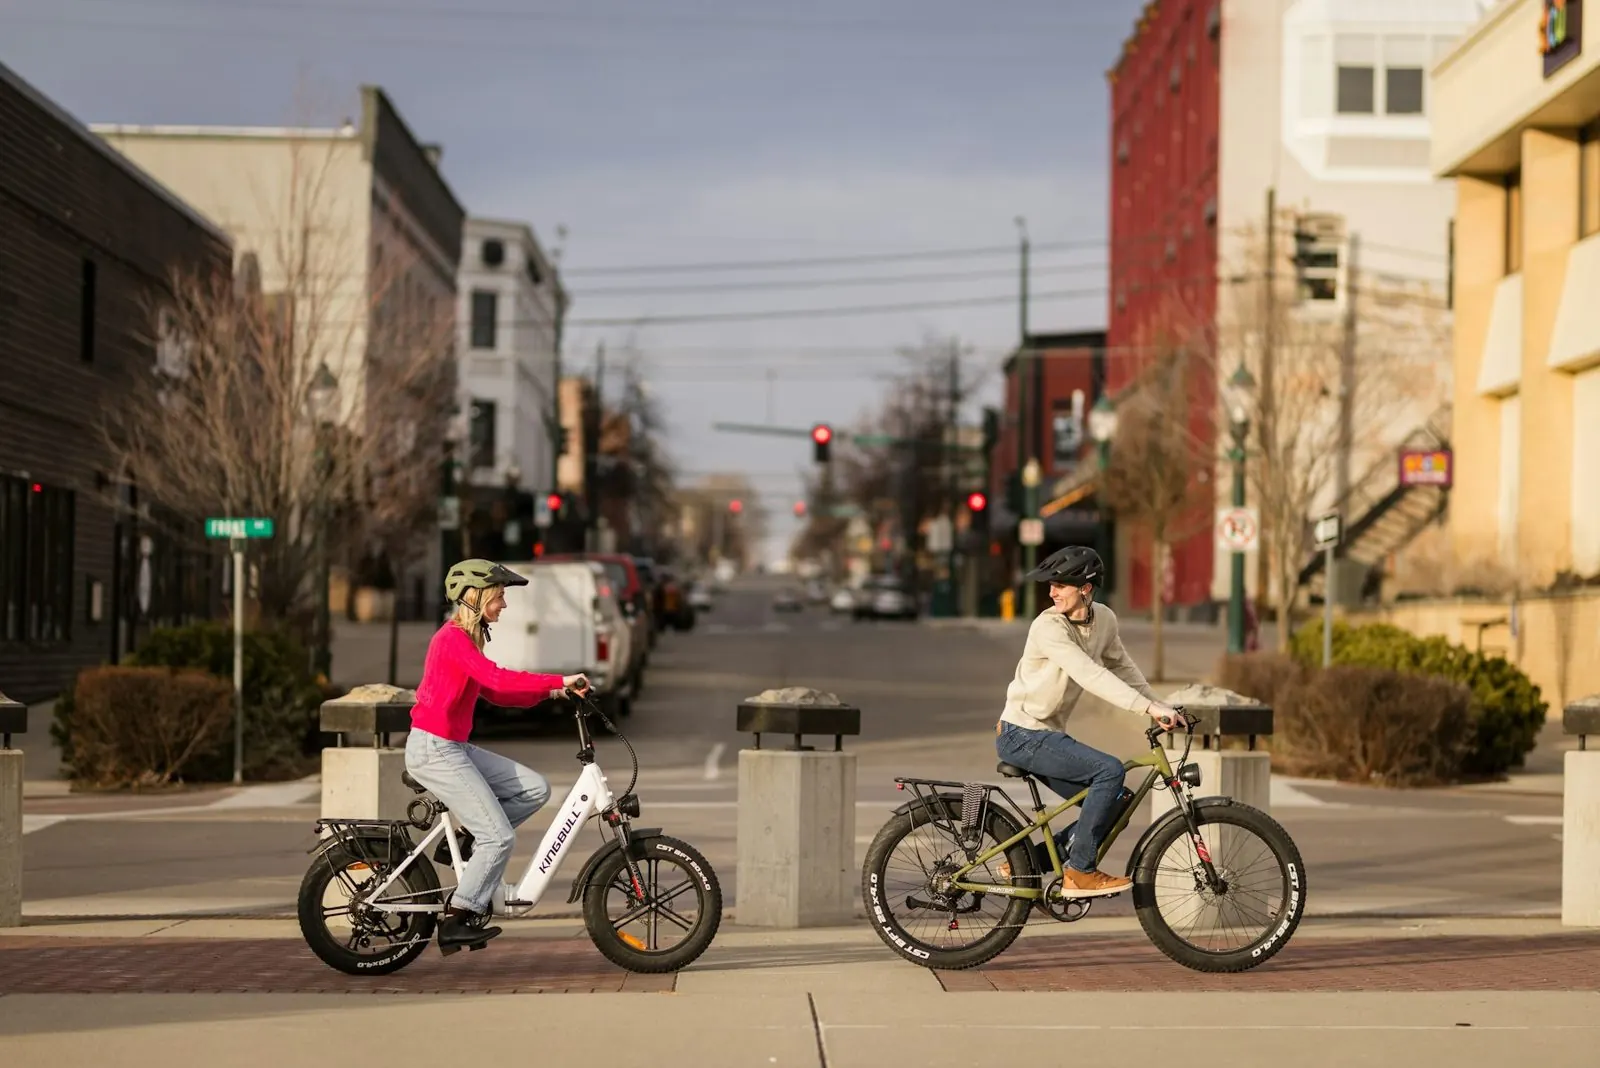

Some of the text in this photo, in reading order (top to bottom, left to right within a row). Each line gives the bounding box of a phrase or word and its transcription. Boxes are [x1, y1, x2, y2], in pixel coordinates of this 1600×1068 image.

[538, 811, 581, 874] KINGBULL
[656, 843, 674, 852] CST
[673, 849, 692, 862] BFT
[1287, 863, 1299, 889] CST
[1287, 890, 1299, 919] BFT
[882, 926, 906, 948] BFT
[392, 946, 409, 961] BFT
[904, 946, 930, 959] CST
